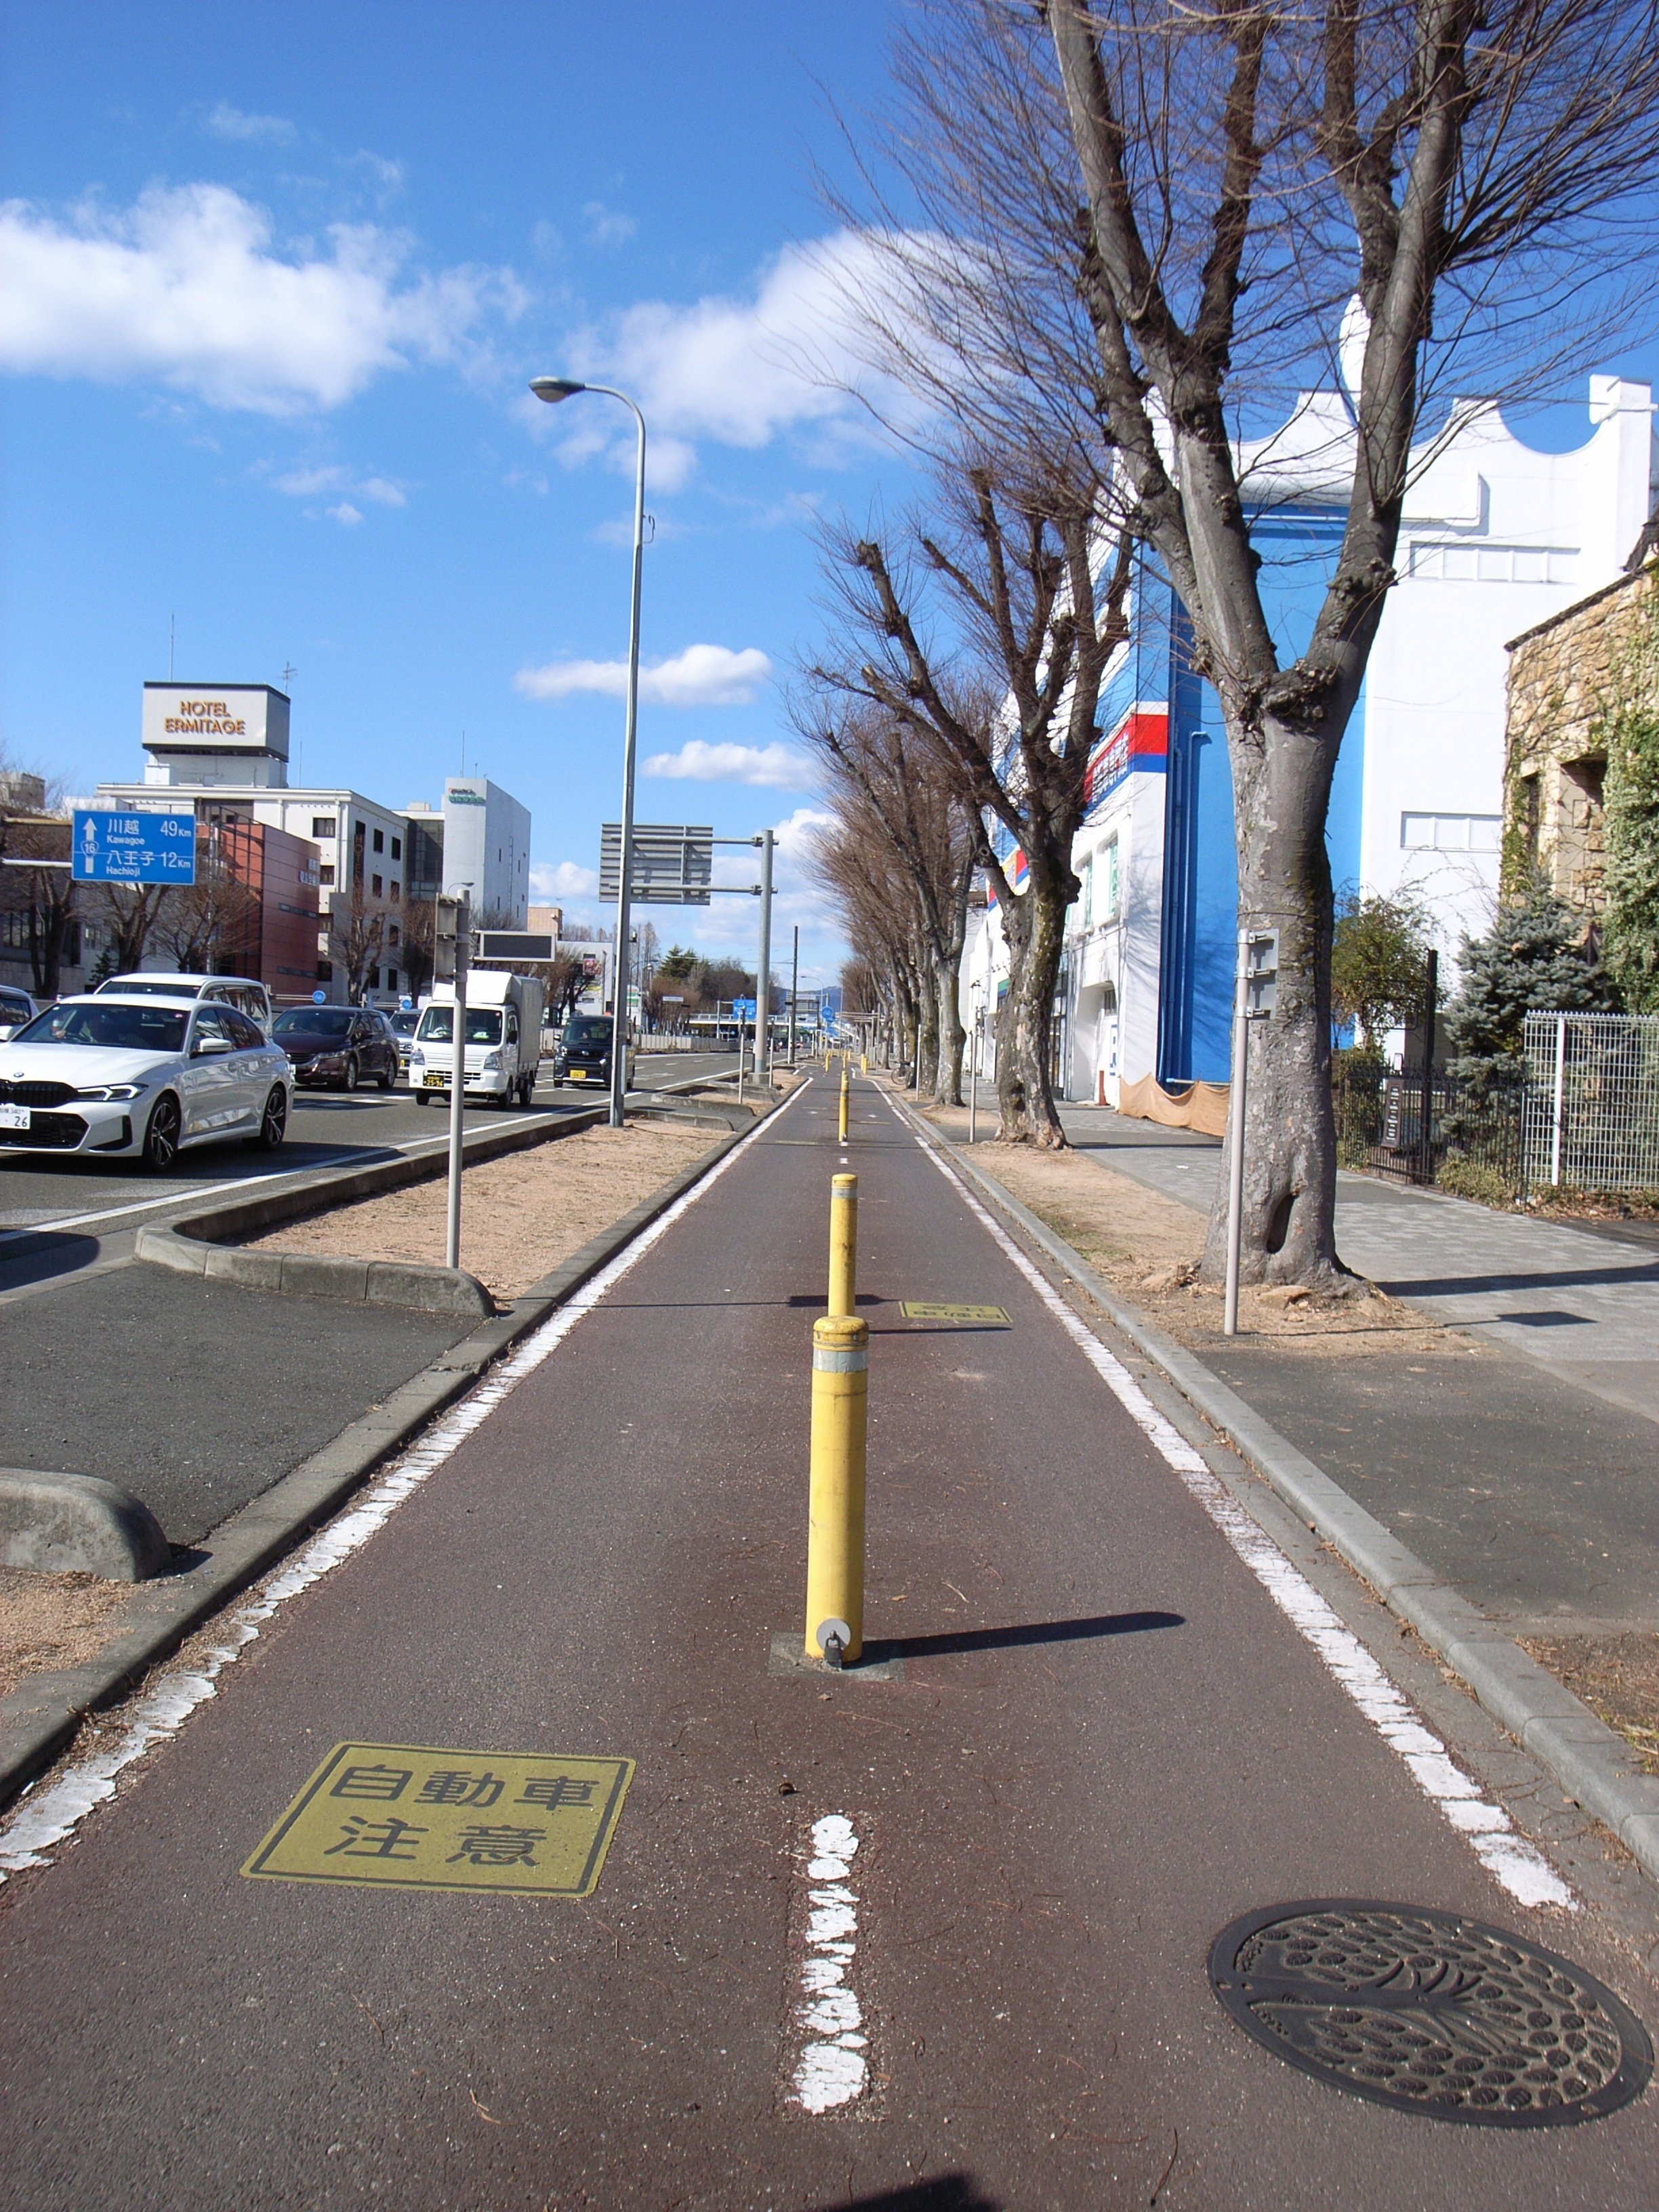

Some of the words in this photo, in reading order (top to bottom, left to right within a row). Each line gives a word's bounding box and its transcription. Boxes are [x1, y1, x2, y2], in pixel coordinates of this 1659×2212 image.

[180, 701, 231, 717] HOTEL
[165, 717, 245, 735] ERMITAGE
[108, 819, 140, 835] 川越
[107, 835, 145, 845] Kawagoe
[84, 843, 96, 854] 16
[107, 850, 155, 867] 八王子
[106, 866, 140, 877] Hachioji
[14, 1115, 28, 1128] 26
[329, 1764, 599, 1810] 自動車
[324, 1816, 546, 1866] 注意
